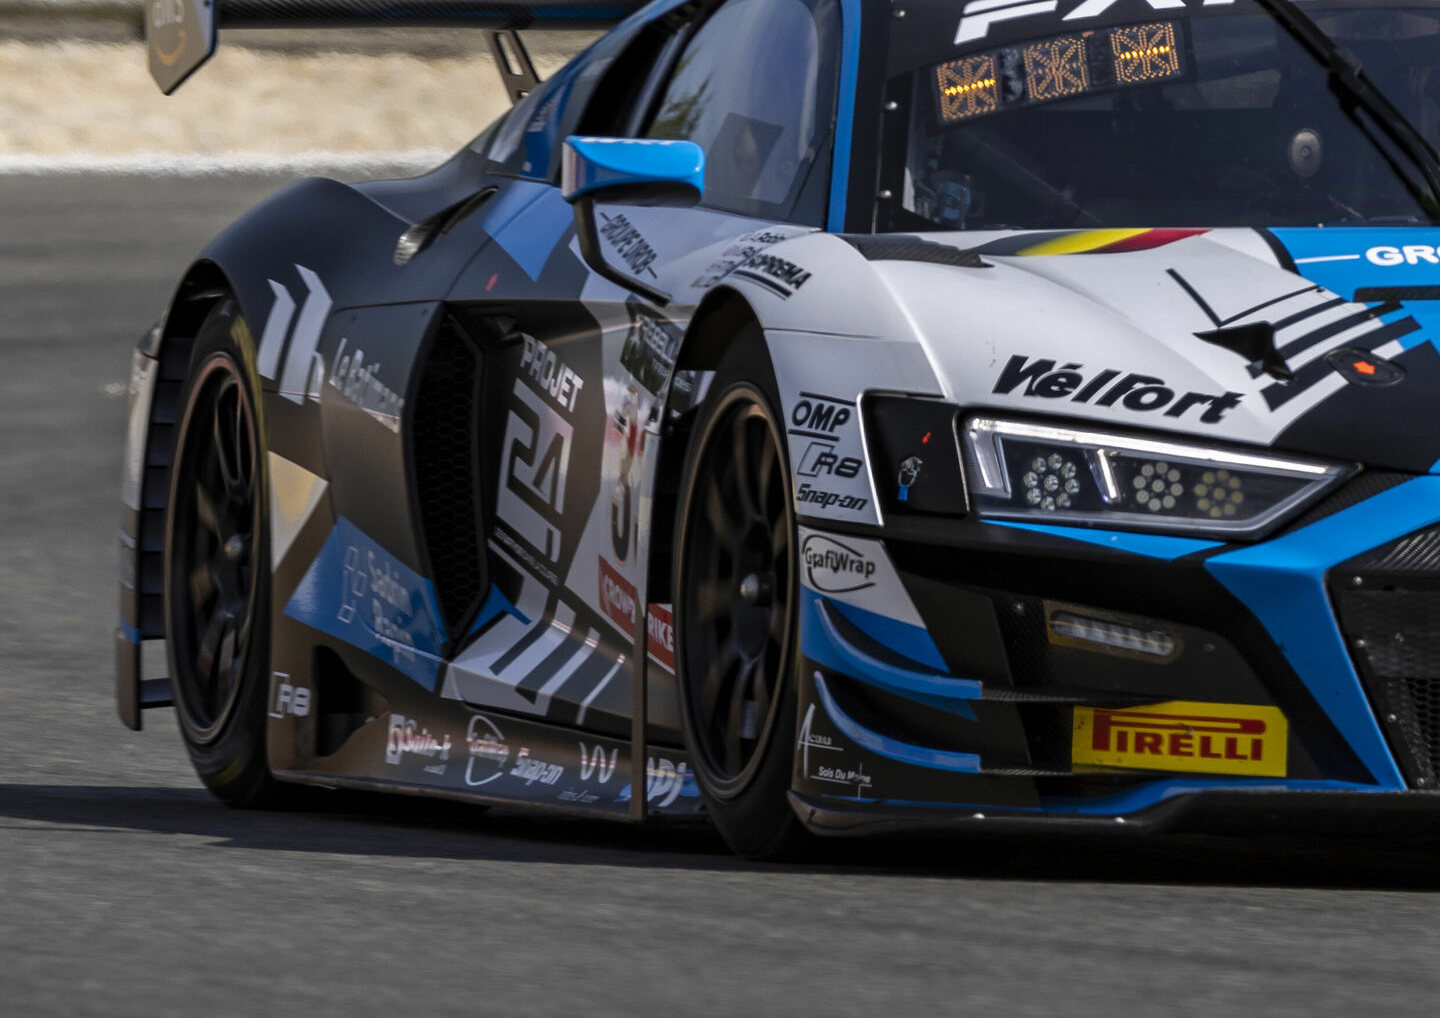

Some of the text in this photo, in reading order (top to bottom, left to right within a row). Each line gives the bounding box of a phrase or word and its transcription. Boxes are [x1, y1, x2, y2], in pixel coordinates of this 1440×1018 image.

[519, 332, 585, 414] PROJET
[791, 399, 851, 433] OMP
[808, 450, 863, 480] R8
[796, 483, 869, 512] Snap-on
[805, 546, 876, 579] GrafiWrap
[1092, 709, 1268, 762] PIRELLI
